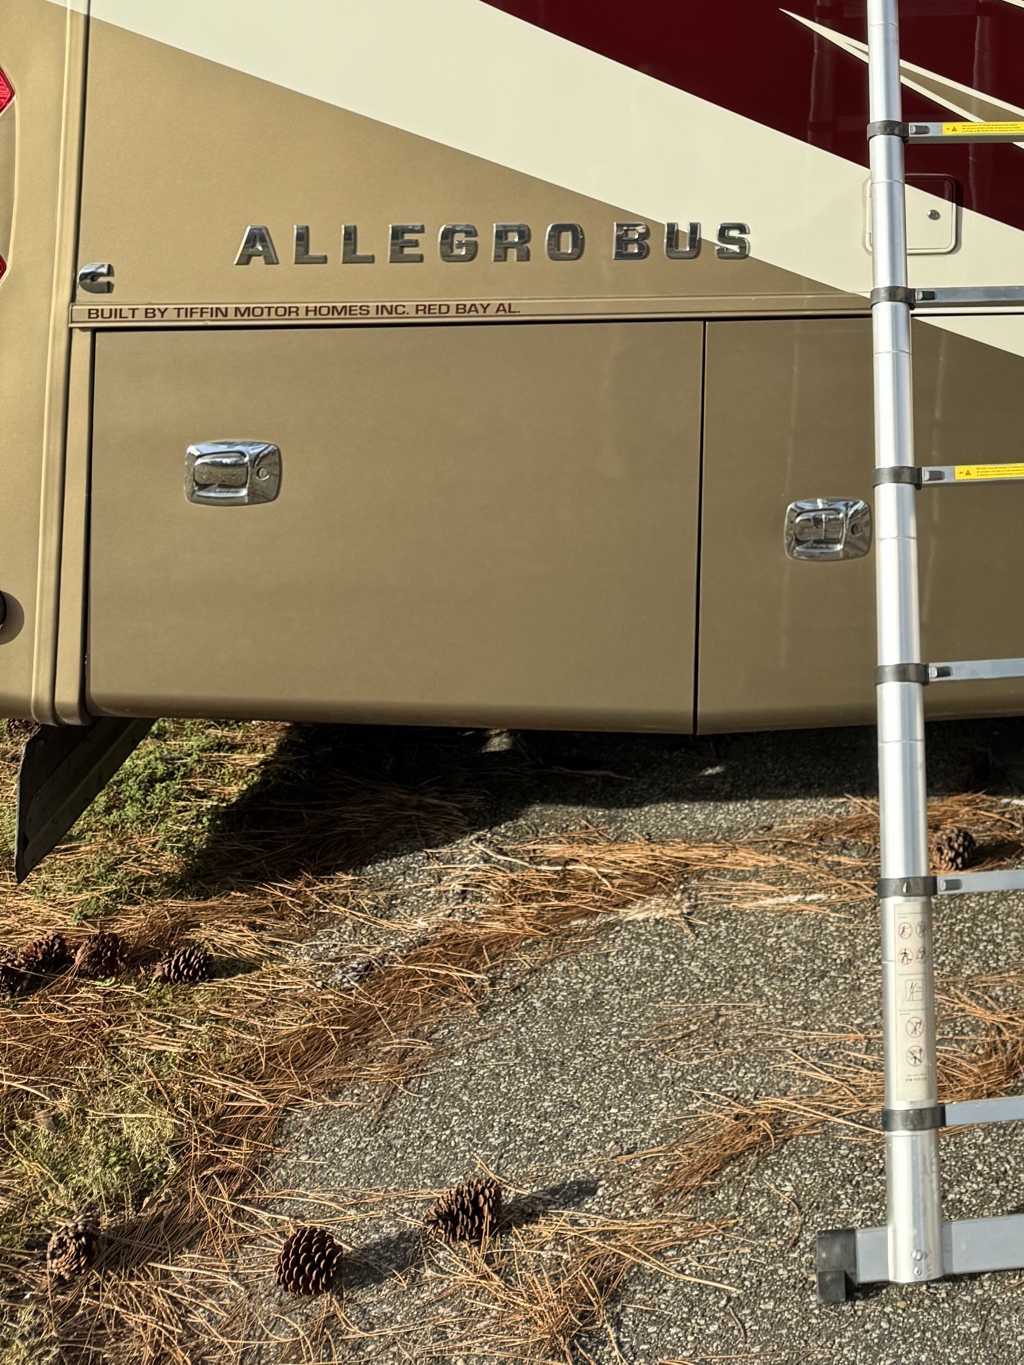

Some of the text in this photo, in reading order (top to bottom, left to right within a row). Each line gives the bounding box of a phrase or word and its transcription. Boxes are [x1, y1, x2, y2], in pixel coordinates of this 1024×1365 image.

[234, 222, 751, 265] ALLEGRO BUS
[87, 302, 521, 320] BUILT BY TIFFIN MOTOR HOMES INC. RED BAY AL.
